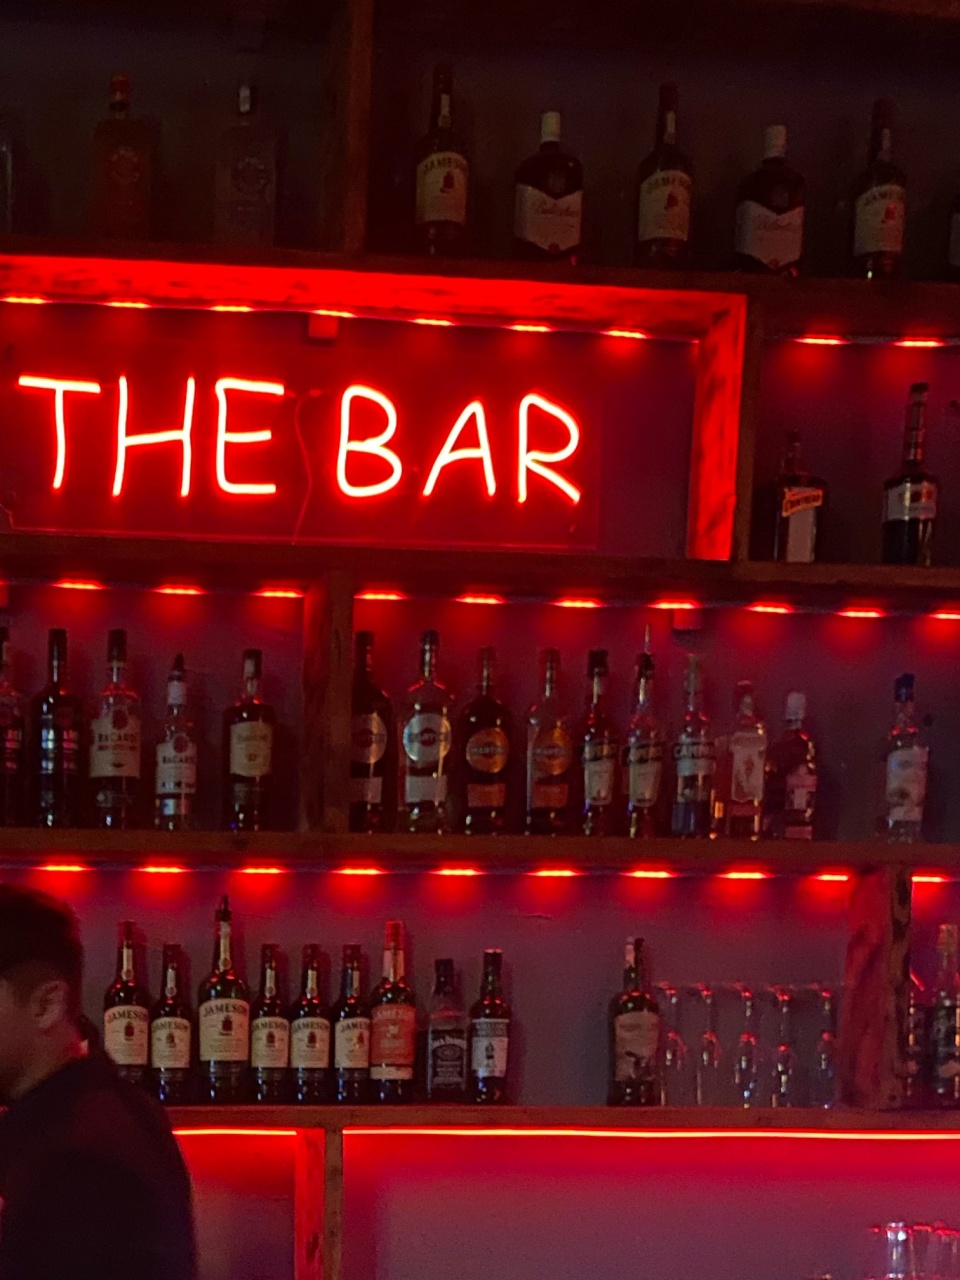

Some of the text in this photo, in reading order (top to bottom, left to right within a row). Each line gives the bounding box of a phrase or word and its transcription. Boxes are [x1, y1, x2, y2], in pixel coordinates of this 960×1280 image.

[16, 373, 584, 507] THE BAR
[107, 1009, 149, 1024] JAMESON
[204, 1003, 249, 1018] JAMESON
